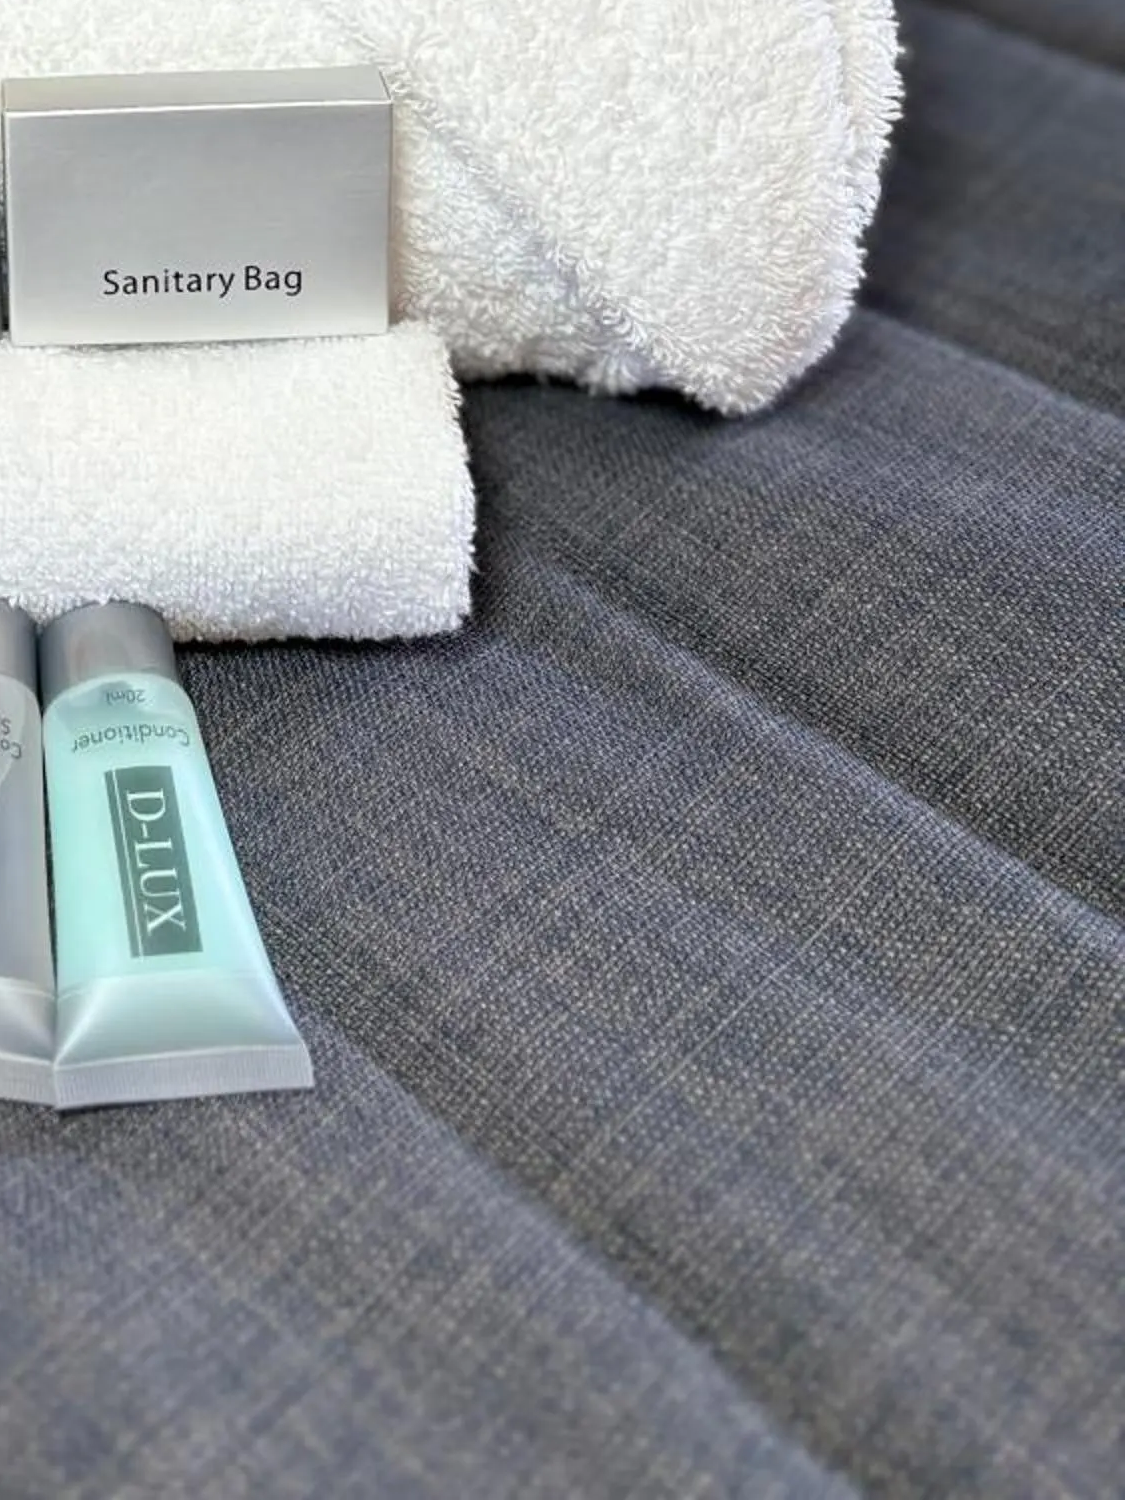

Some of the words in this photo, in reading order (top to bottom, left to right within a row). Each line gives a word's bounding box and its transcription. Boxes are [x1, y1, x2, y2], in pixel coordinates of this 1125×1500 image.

[103, 268, 236, 298] Sanitary
[244, 265, 303, 297] Bag
[105, 688, 146, 705] 20ml
[73, 719, 190, 754] Conditioner
[126, 787, 187, 937] D-LUX
